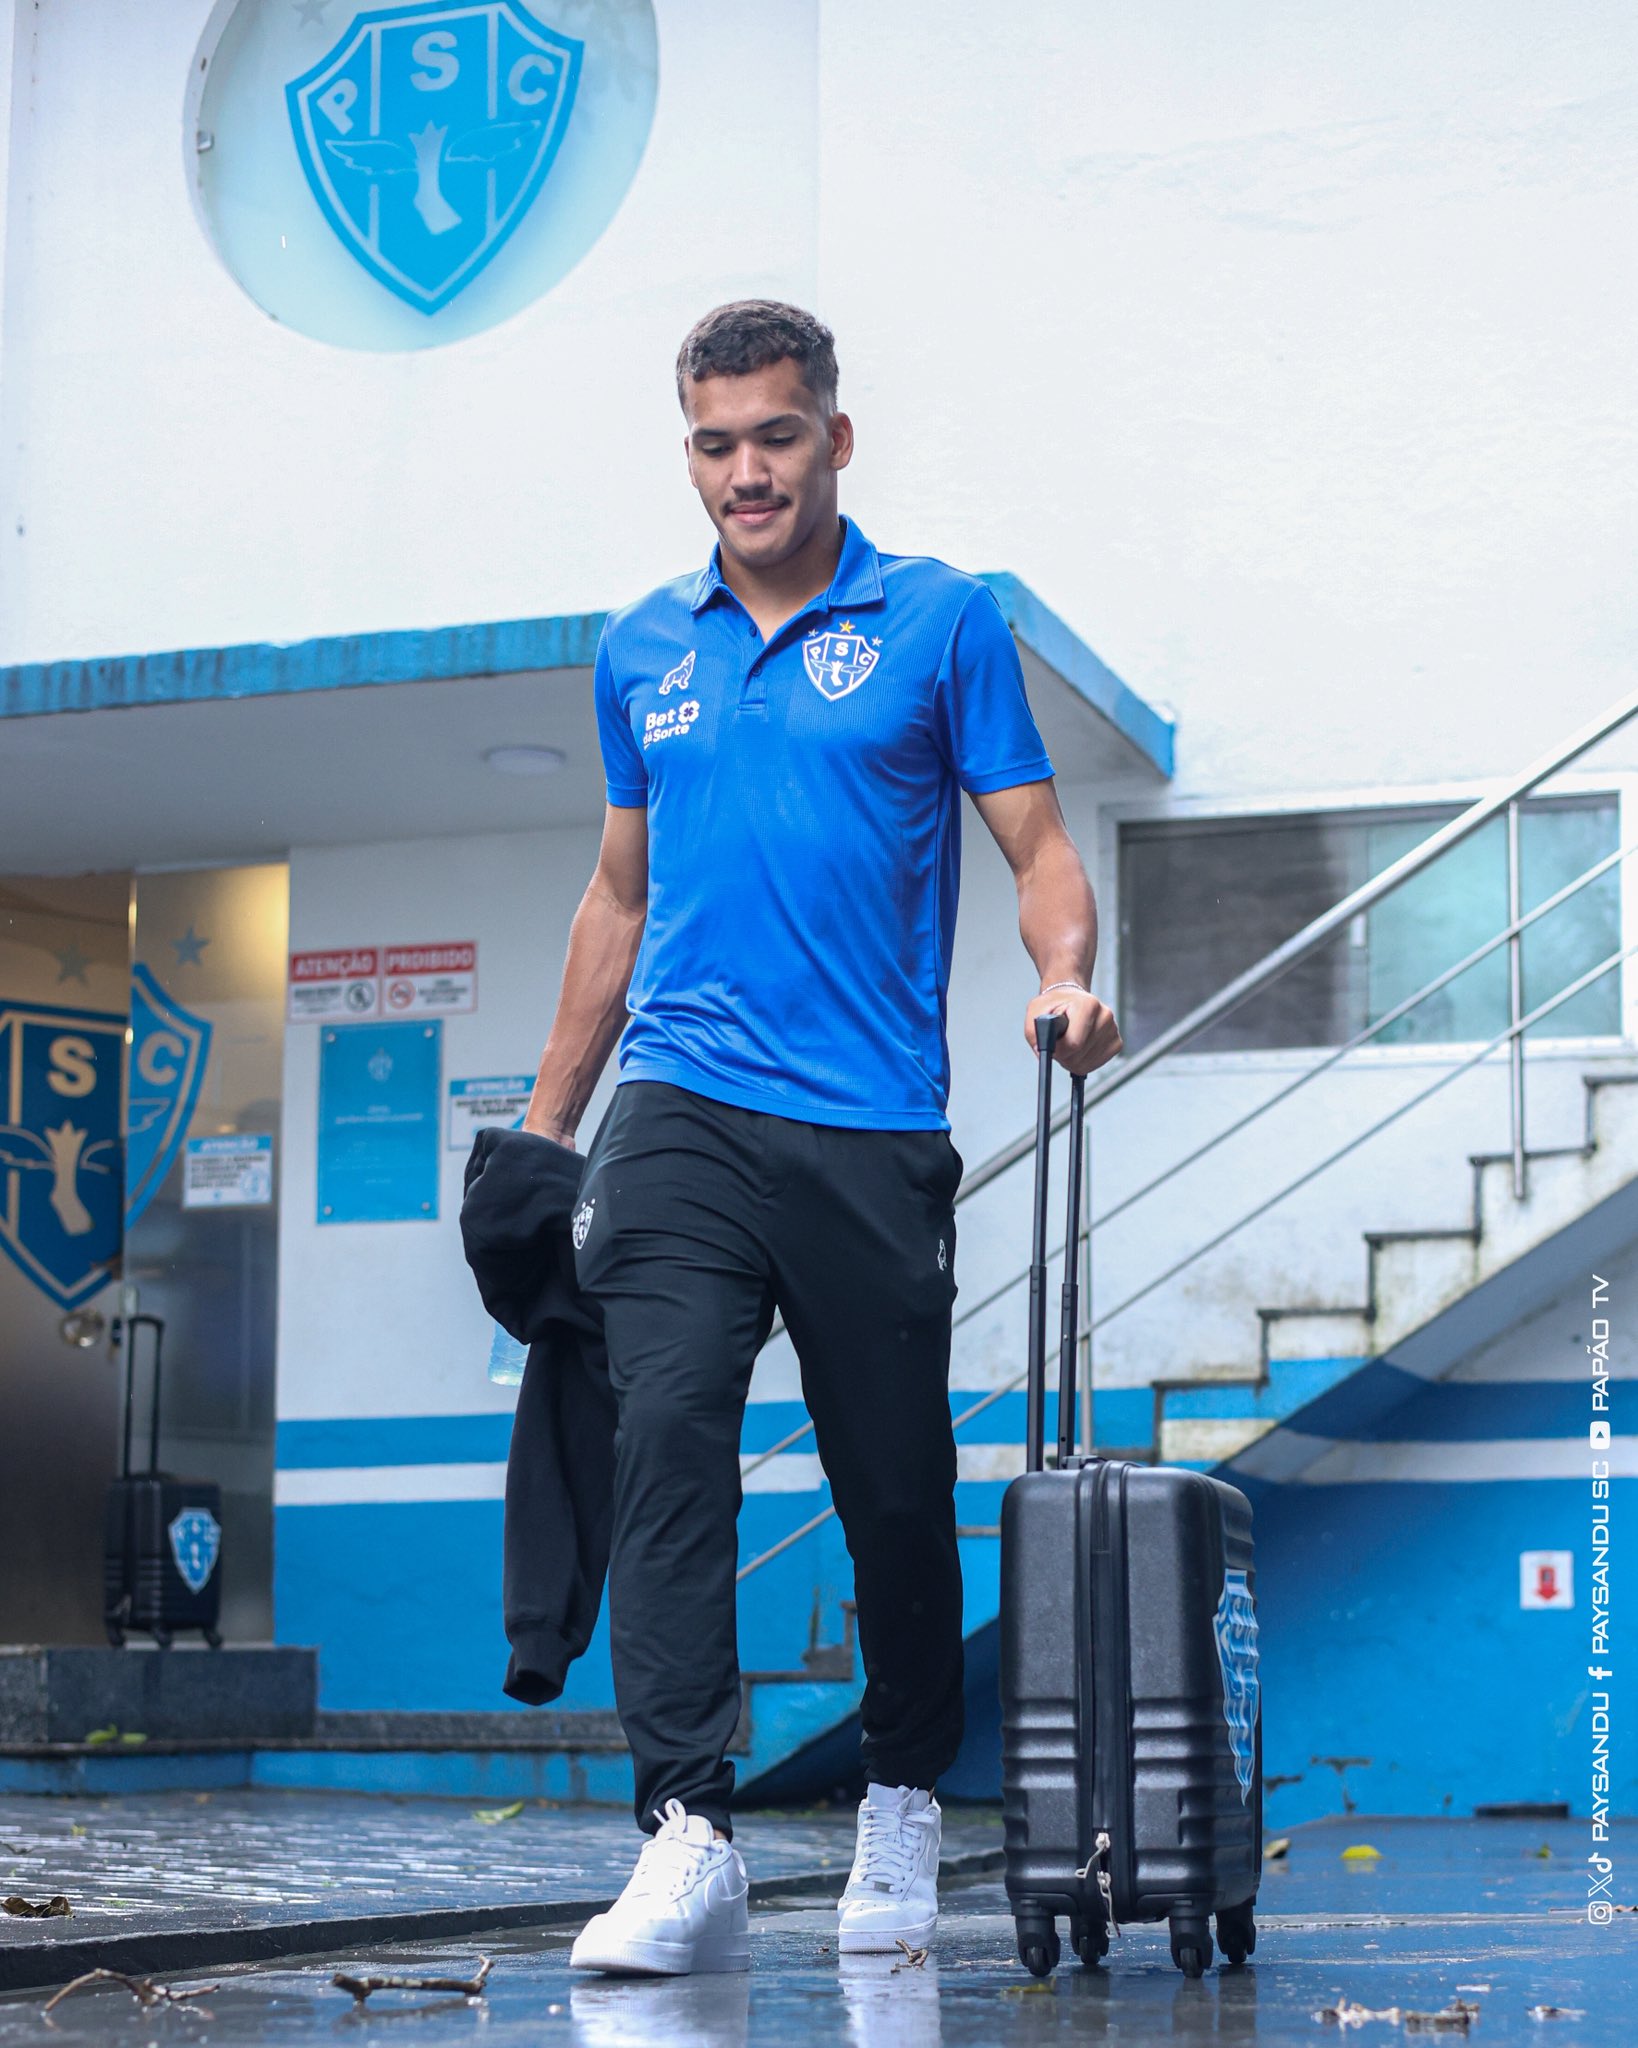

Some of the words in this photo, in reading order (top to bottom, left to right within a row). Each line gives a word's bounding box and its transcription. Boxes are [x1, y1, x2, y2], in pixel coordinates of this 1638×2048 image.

[645, 708, 677, 731] Bet
[653, 724, 690, 743] Sorte
[296, 952, 374, 977] ATENÇÃO
[388, 949, 474, 972] PROIBIDO
